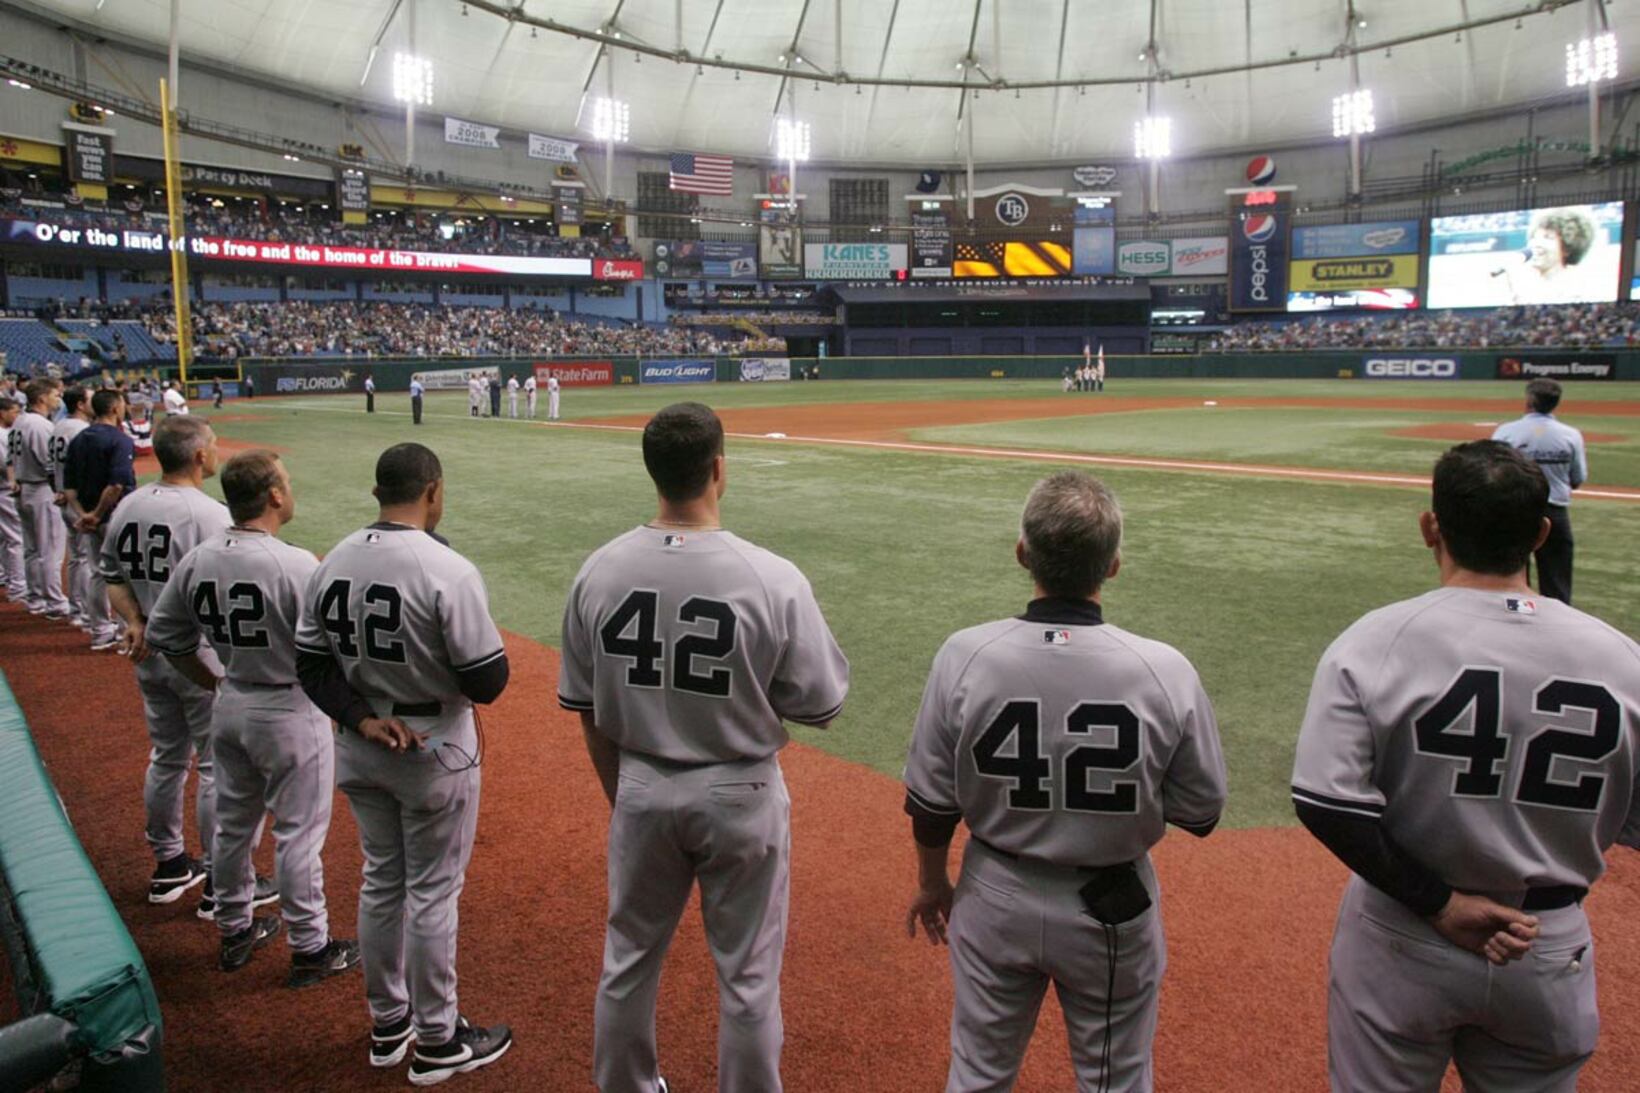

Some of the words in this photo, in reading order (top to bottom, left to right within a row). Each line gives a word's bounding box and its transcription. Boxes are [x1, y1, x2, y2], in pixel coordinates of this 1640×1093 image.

[35, 223, 80, 244] O'er
[86, 228, 118, 247] the
[124, 230, 163, 250] land
[168, 236, 186, 252] of
[191, 238, 219, 256] the
[223, 240, 257, 258] free
[261, 244, 291, 261] and
[295, 246, 321, 262] the
[324, 247, 366, 264] home
[370, 251, 385, 265] of
[389, 251, 413, 266] the
[1121, 251, 1166, 264] HESS
[1250, 245, 1269, 301] pepsi
[1316, 262, 1390, 278] STANLEY
[295, 376, 346, 390] FLORIDA
[644, 367, 672, 377] BUD
[677, 366, 712, 377] LIGHT
[1365, 359, 1456, 377] GEICO
[1522, 362, 1570, 377] Progress
[1570, 363, 1610, 376] Energy
[116, 521, 173, 582] 42
[195, 579, 272, 649] 42
[319, 578, 408, 664] 42
[600, 587, 740, 698] 42
[971, 697, 1142, 814] 42
[1411, 664, 1625, 813] 42
